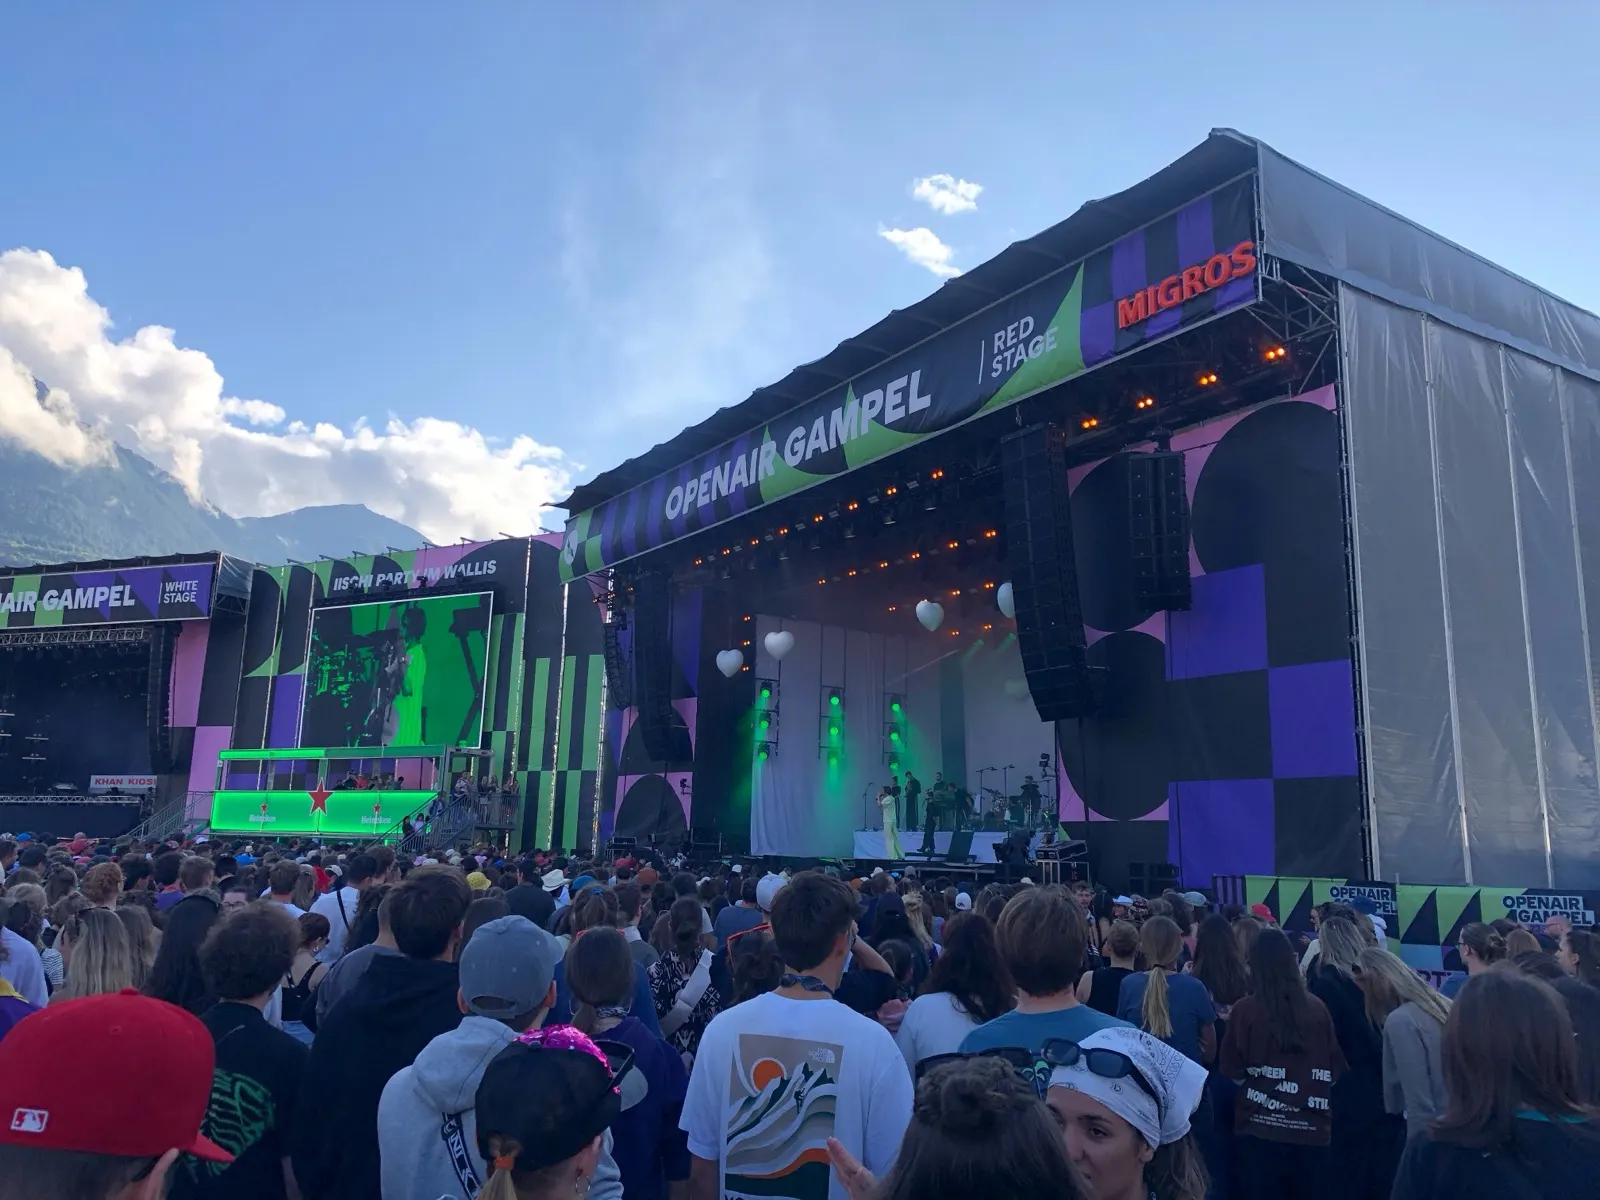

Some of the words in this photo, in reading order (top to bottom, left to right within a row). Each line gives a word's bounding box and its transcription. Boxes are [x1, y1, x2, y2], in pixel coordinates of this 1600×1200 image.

[1118, 241, 1256, 329] MIGROS
[993, 316, 1035, 354] RED
[991, 326, 1058, 378] STAGE
[665, 440, 777, 520] OPENAIR
[784, 369, 931, 467] GAMPEL
[165, 580, 199, 592] WHITE
[333, 574, 374, 591] IISCHI
[376, 569, 422, 587] PARTY
[423, 566, 441, 580] IM
[444, 559, 497, 579] WALLIS
[0, 590, 38, 614] AIR
[42, 584, 136, 611] GAMPEL
[163, 592, 197, 604] STAGE
[1329, 886, 1391, 901] OPENAIR
[1502, 895, 1581, 910] OPENAIR
[1311, 1068, 1332, 1082] THE
[1274, 1081, 1299, 1094] AND
